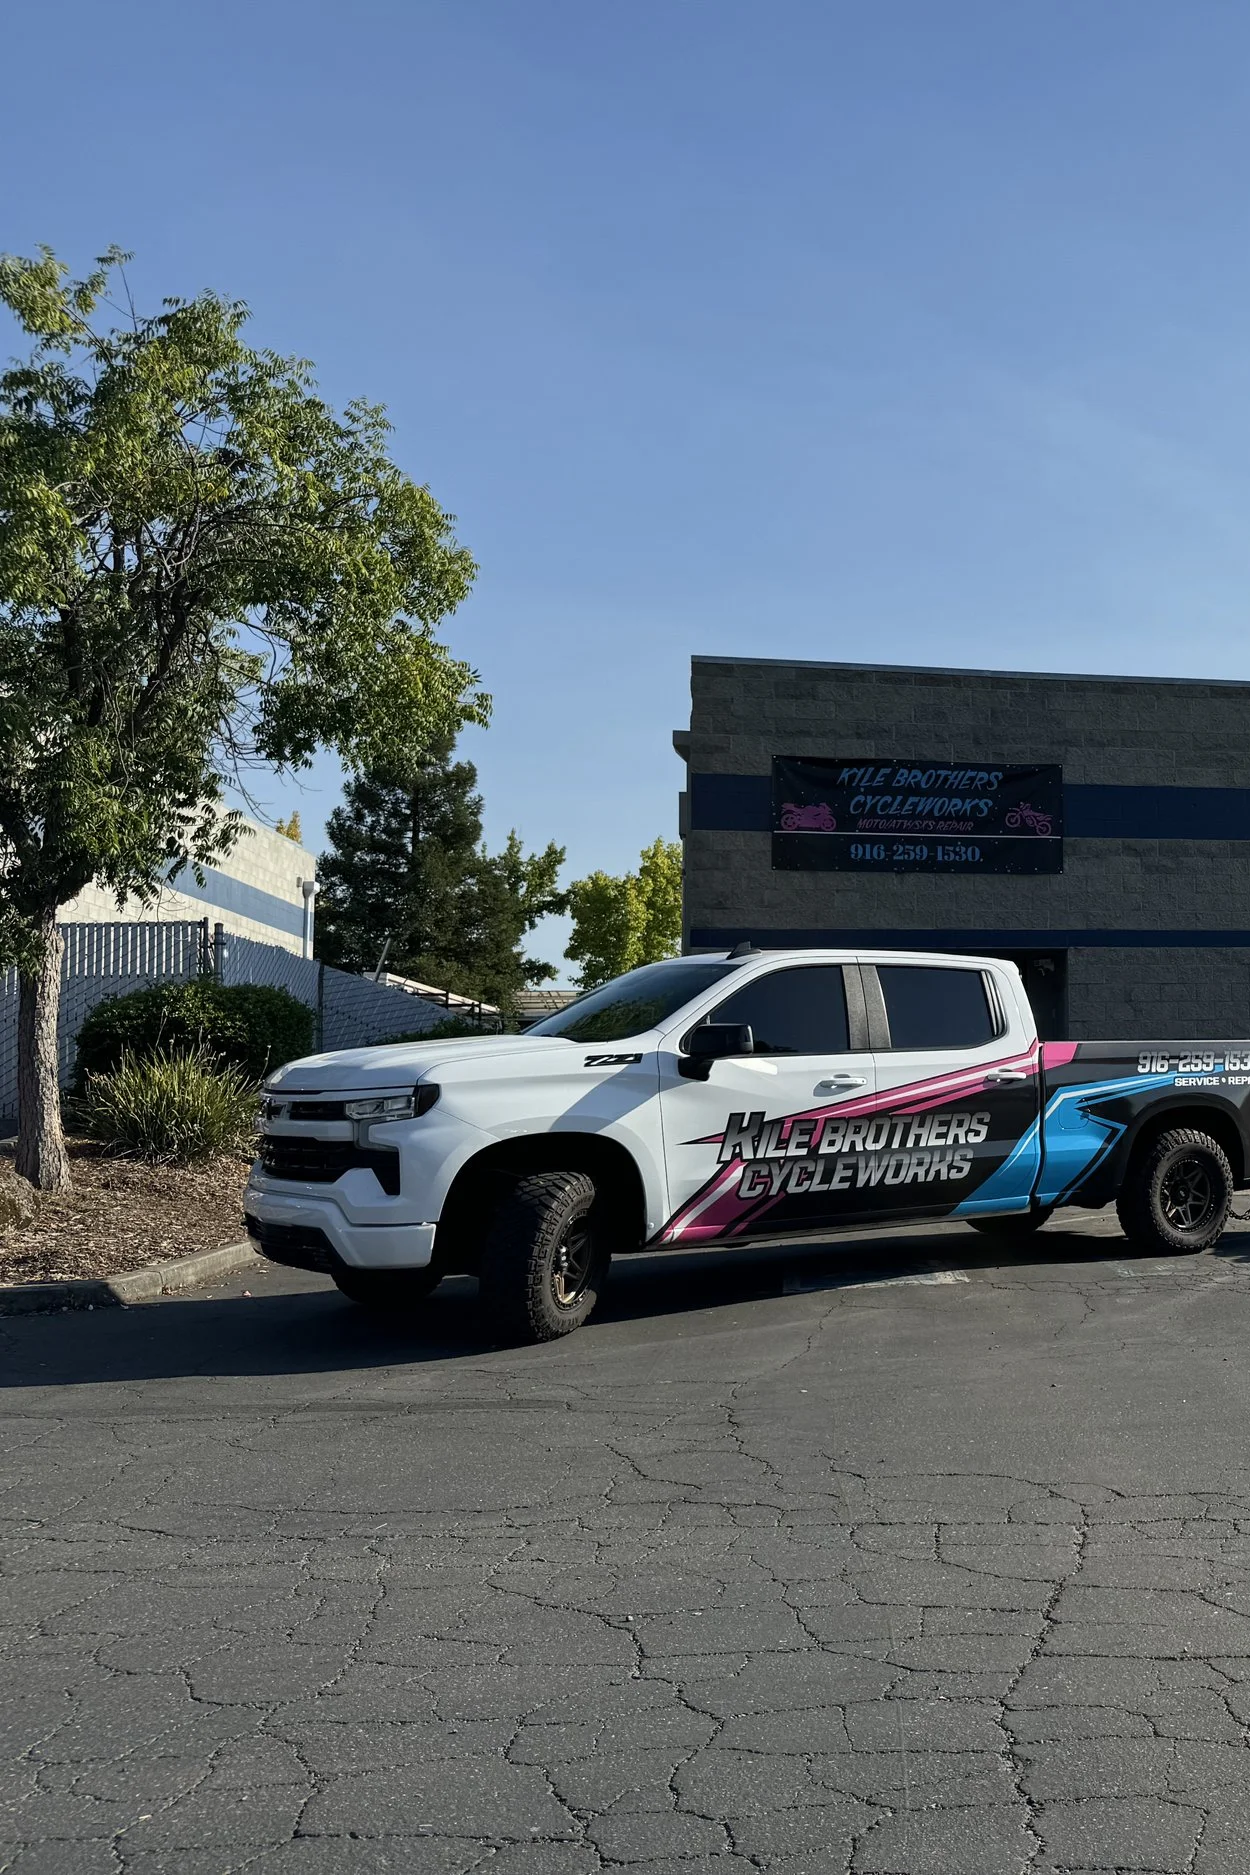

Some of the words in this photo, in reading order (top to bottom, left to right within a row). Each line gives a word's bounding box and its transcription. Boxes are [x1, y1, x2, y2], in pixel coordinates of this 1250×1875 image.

[892, 768, 1003, 791] BROTHERS
[849, 795, 993, 817] CYCLEWORKS
[936, 820, 974, 831] REPAIR
[850, 843, 981, 862] 916-259-1530
[584, 1052, 644, 1067] Z71
[1174, 1076, 1220, 1087] SERVICE
[717, 1111, 818, 1164] KILE
[819, 1111, 991, 1155] BROTHERS
[738, 1149, 974, 1199] CYCLEWORKS
